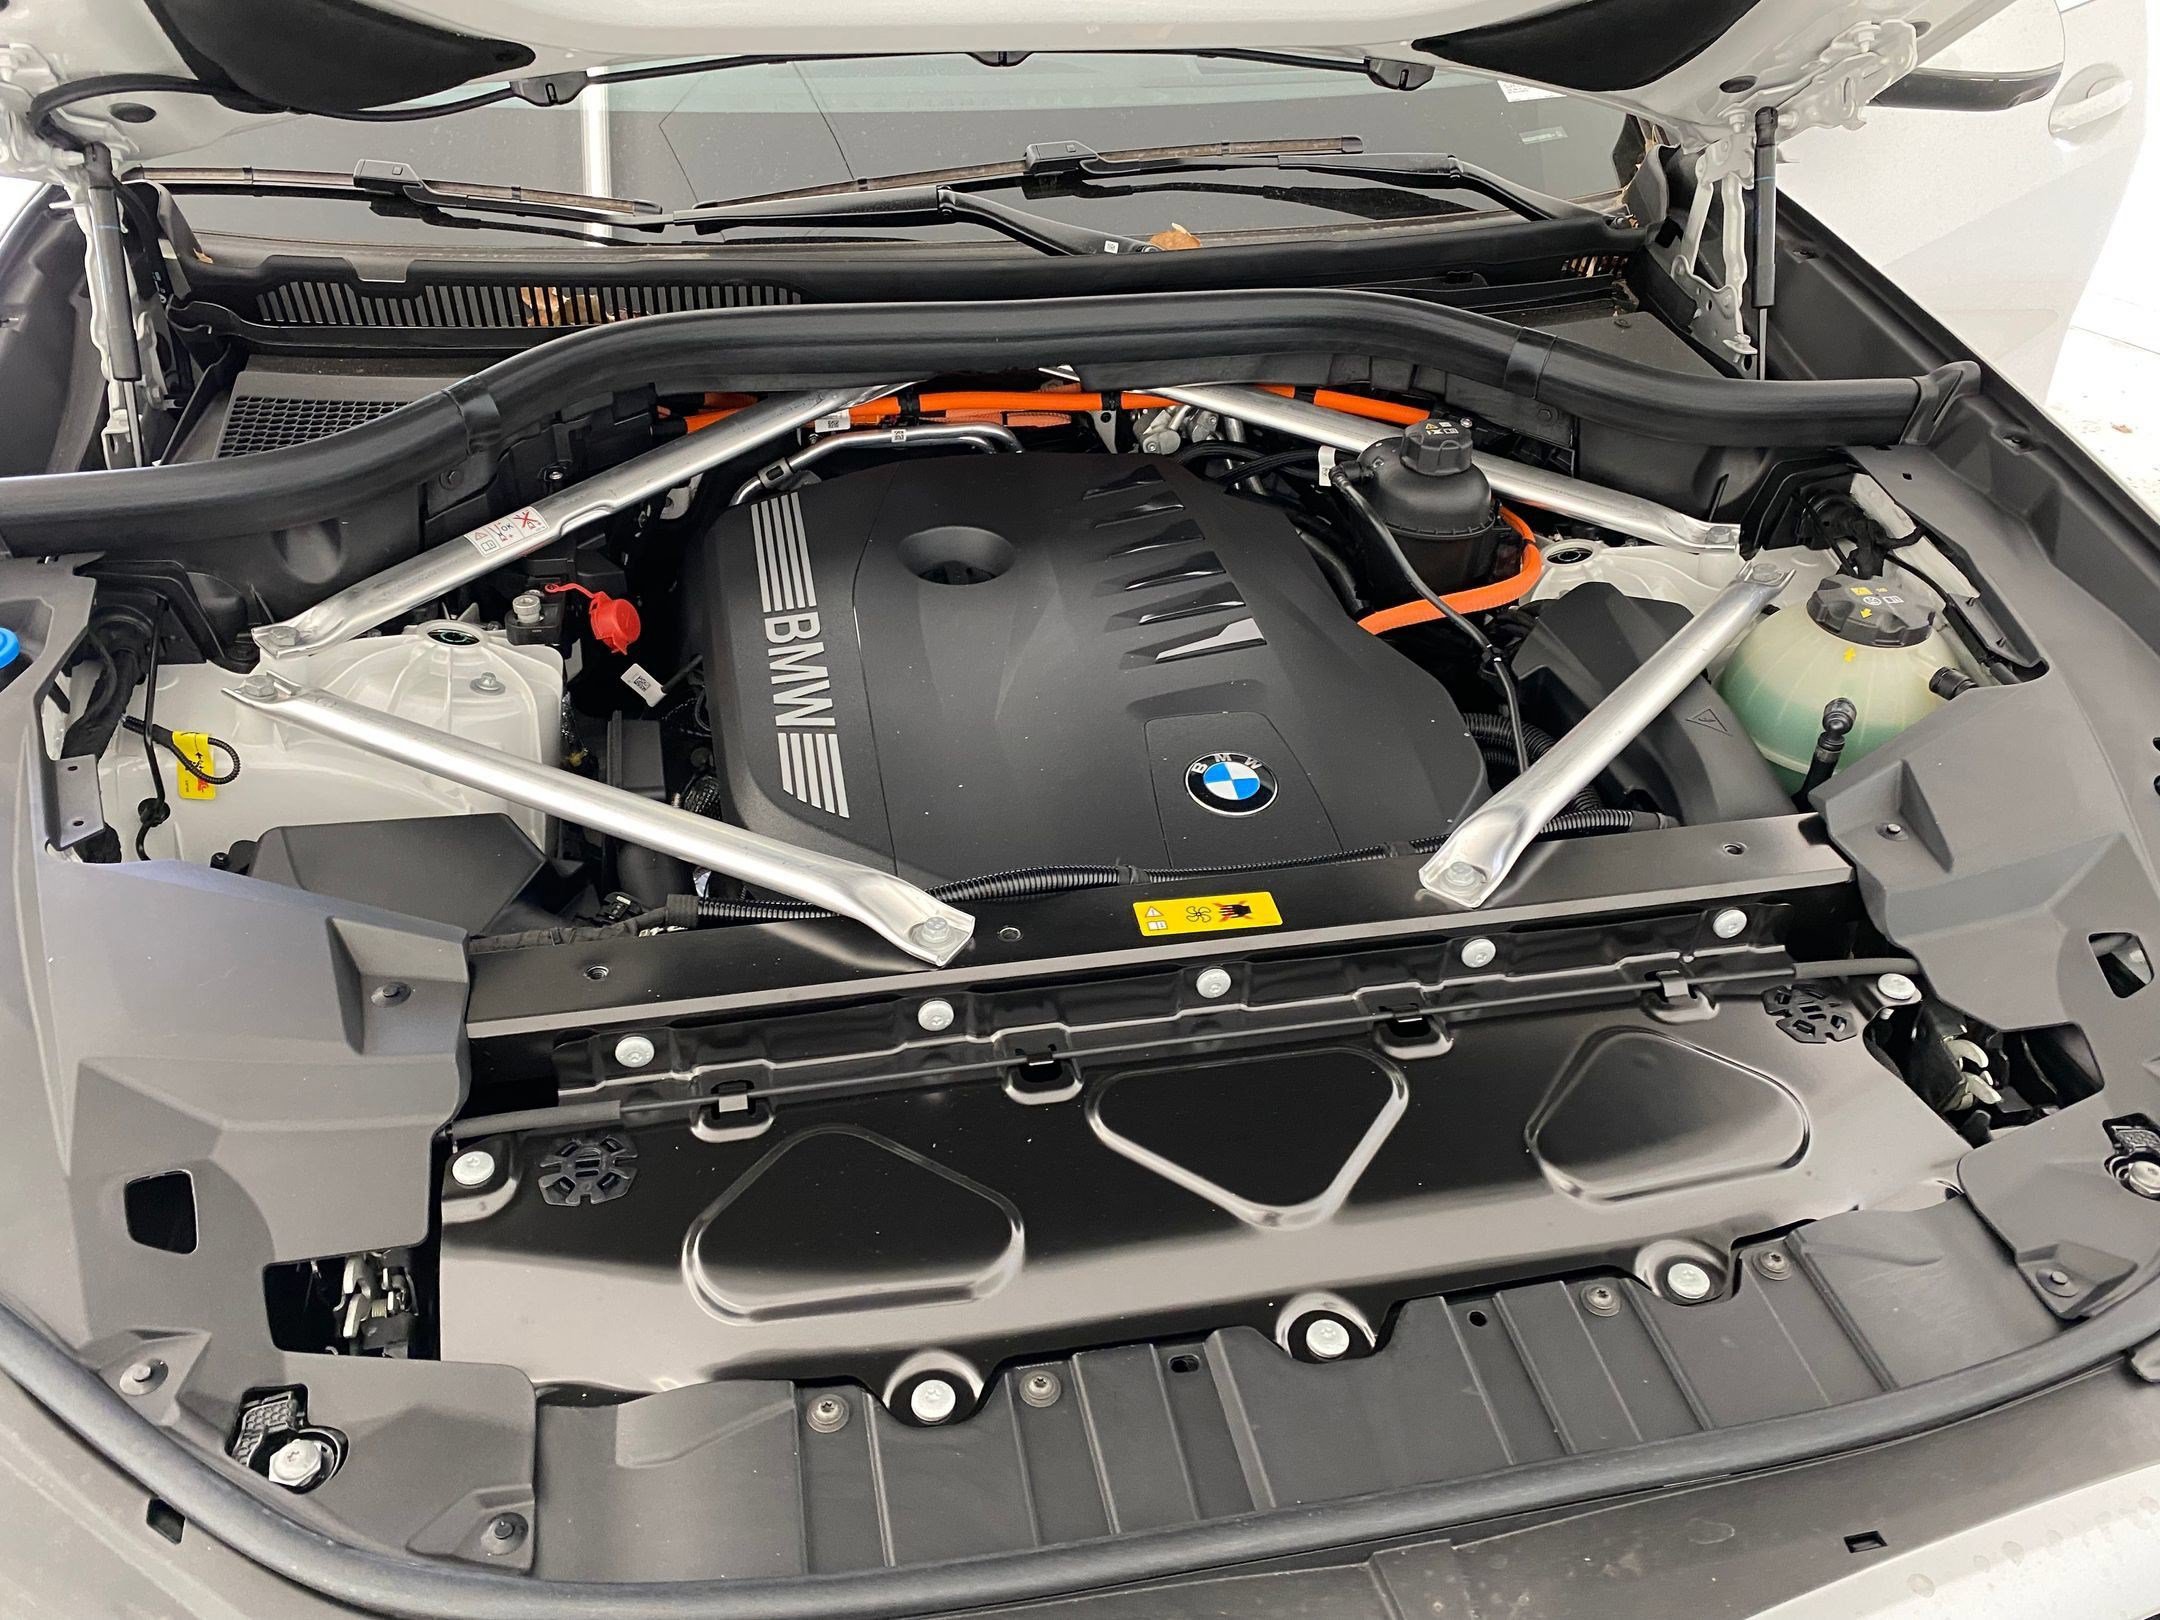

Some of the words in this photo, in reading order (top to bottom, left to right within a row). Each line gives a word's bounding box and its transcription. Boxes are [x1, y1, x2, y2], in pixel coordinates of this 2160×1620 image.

[501, 523, 514, 532] OK
[764, 611, 836, 727] BMW
[1191, 753, 1263, 774] BMW
